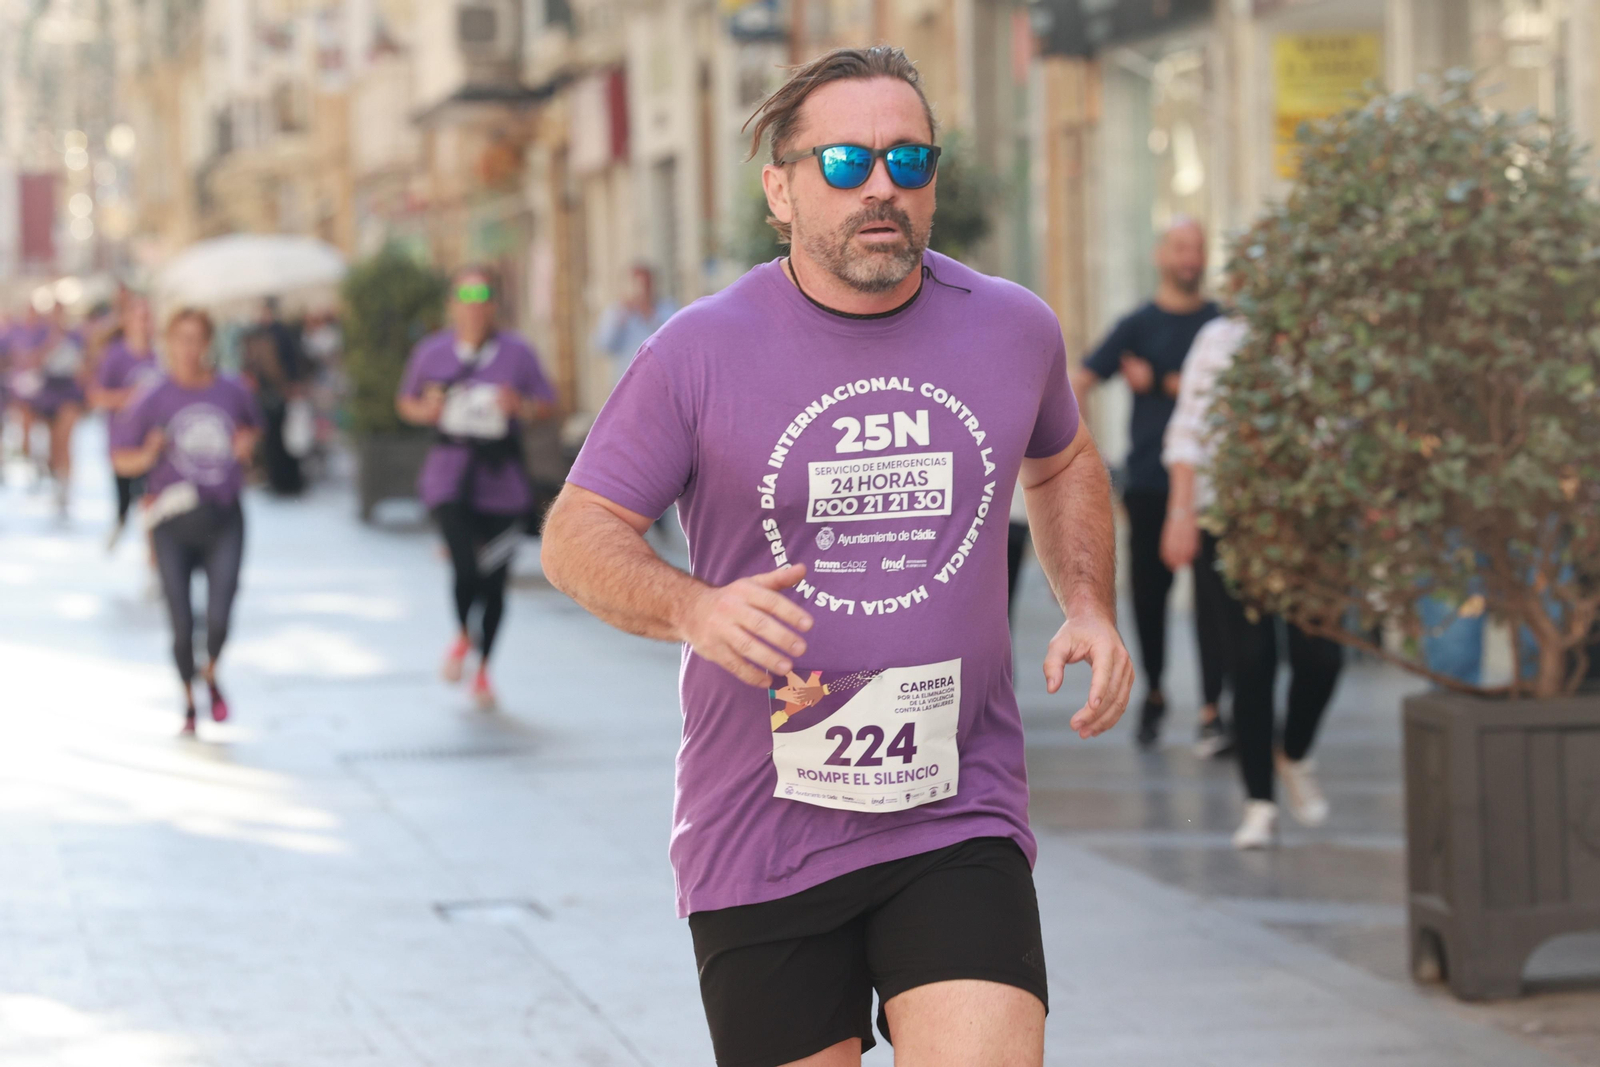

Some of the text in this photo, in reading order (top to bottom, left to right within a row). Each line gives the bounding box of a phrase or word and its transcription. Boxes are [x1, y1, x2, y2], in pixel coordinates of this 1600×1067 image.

[767, 377, 915, 469] INTERNACIONAL
[920, 382, 987, 447] CONTRA
[831, 409, 931, 454] 25N
[814, 457, 947, 476] SERVICIO DE EMERGENCIAS
[980, 446, 996, 477] LA
[757, 473, 779, 509] DÍA
[831, 470, 929, 495] 24 HORAS
[814, 491, 943, 516] 900 21 21 30
[837, 528, 937, 547] Ayuntamiento de Cádiz
[932, 480, 996, 584] VIOLENCIA
[881, 554, 906, 571] imd
[814, 591, 856, 616] LAS
[860, 585, 929, 616] HACIA
[900, 675, 955, 693] CARRERA
[894, 706, 921, 714] CONTRA
[933, 699, 954, 709] MUJERES
[927, 693, 954, 704] VIOLENCIA
[823, 722, 918, 767] 224
[797, 764, 939, 786] ROMPE EL SILENCIO
